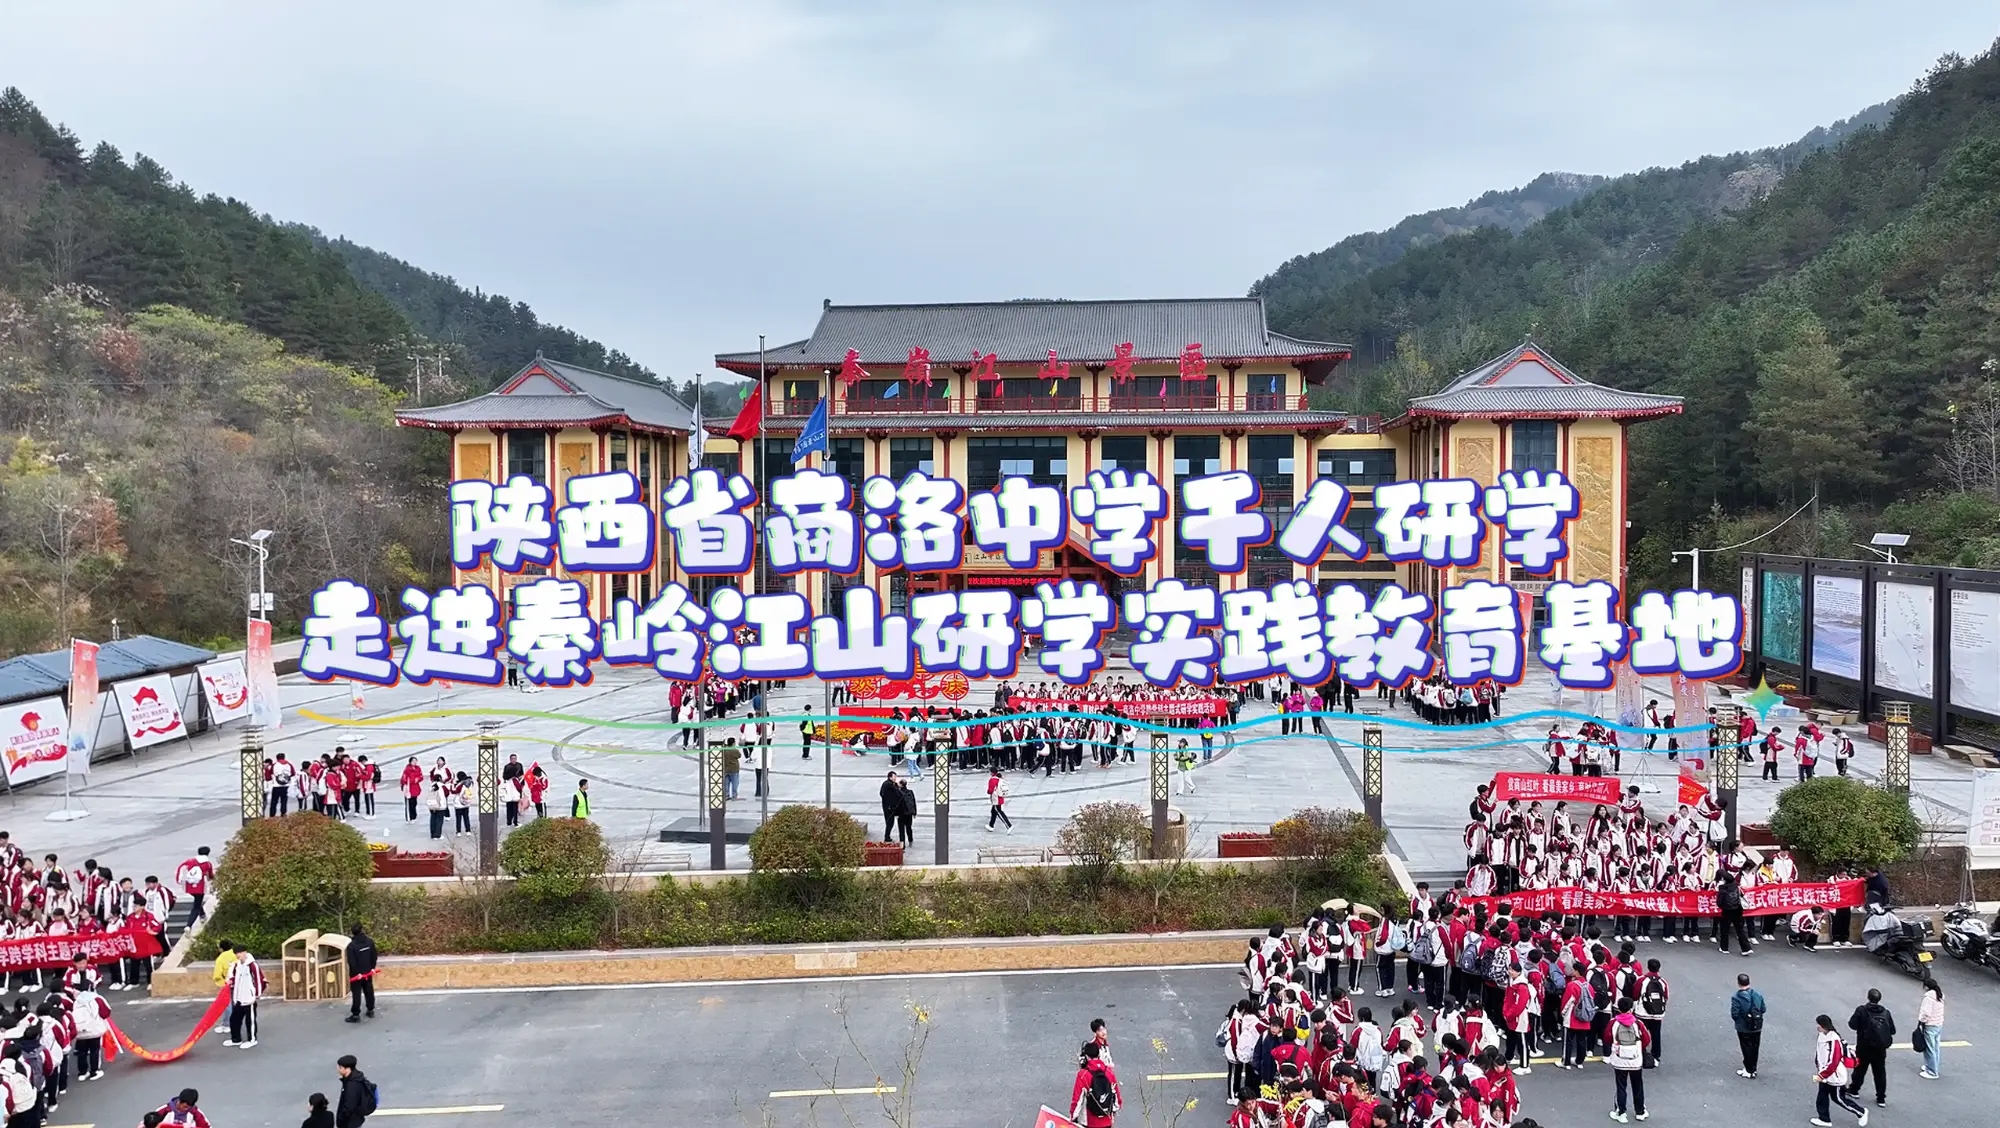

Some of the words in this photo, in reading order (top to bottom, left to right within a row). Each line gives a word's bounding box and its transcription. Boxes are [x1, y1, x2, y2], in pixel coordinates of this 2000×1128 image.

[1697, 886, 1841, 914] 跨学题式研学实践活动
